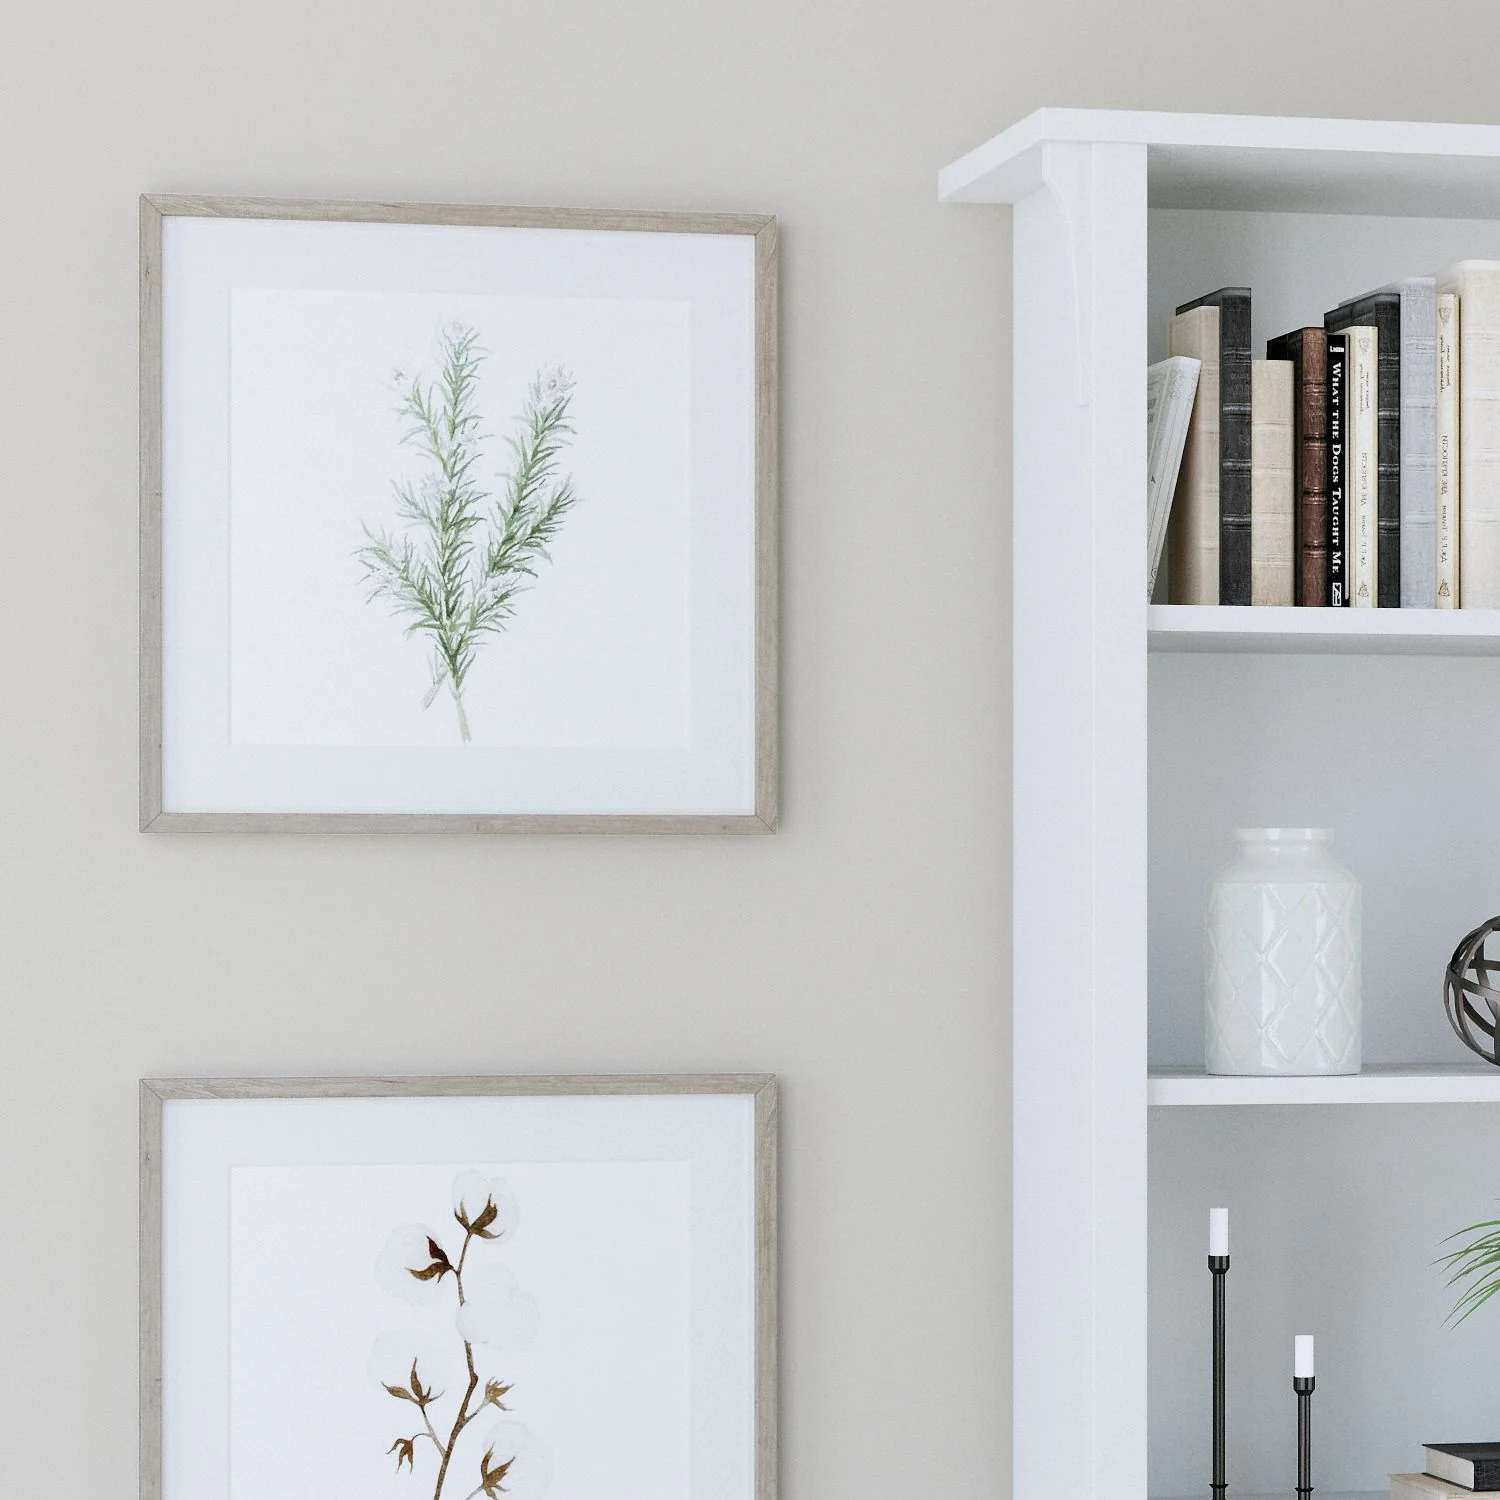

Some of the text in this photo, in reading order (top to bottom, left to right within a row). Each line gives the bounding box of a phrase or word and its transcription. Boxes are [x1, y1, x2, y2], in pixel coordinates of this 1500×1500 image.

[1331, 362, 1342, 406] WHAT
[1331, 409, 1340, 439] THE
[1331, 444, 1342, 483] DOGS
[1331, 487, 1342, 547] TAUGHT
[1331, 551, 1342, 574] ME
